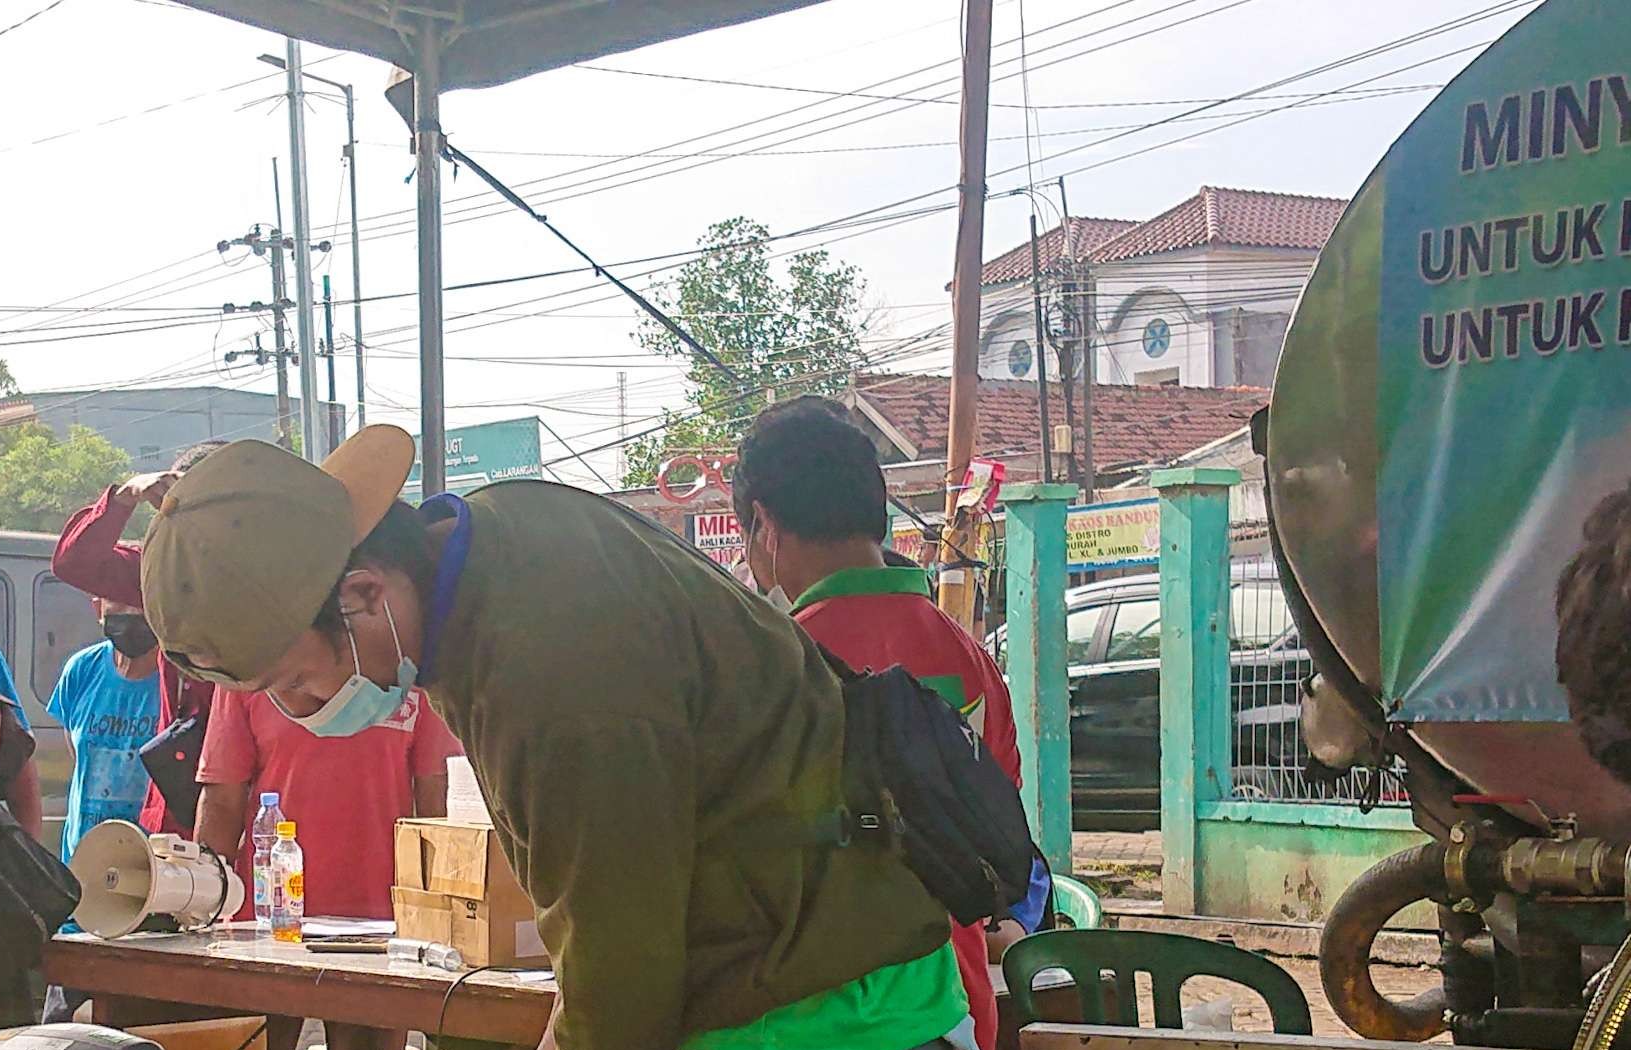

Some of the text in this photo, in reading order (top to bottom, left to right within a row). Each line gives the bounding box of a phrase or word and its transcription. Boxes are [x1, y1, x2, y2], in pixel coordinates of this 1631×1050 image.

[1419, 202, 1608, 284] UNTUK
[1421, 288, 1606, 369] UNTUK
[1075, 529, 1111, 540] DISTRO
[1105, 544, 1139, 556] JUMBO
